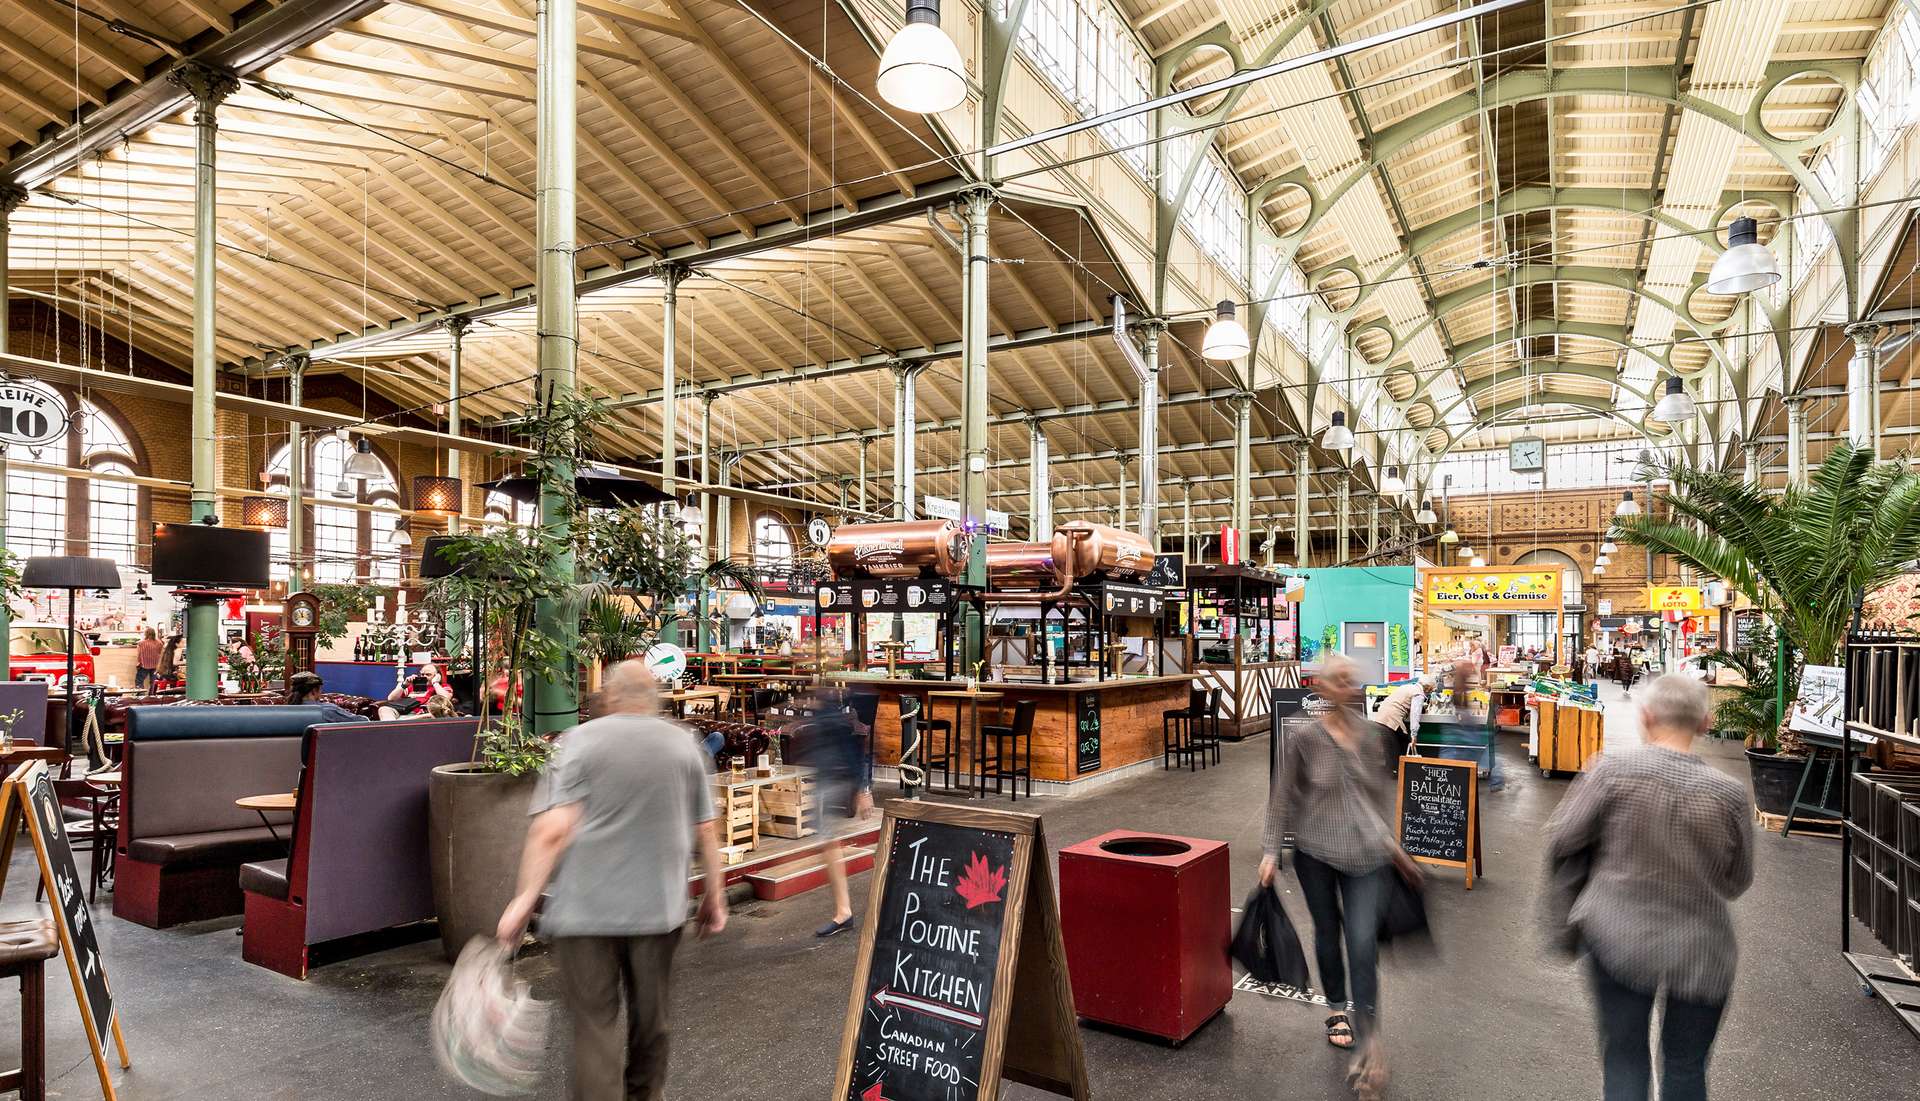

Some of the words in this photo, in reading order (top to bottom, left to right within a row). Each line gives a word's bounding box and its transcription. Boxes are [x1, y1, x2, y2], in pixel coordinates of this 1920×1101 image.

[816, 528, 824, 543] 9
[1436, 592, 1462, 600] Eier,
[1464, 592, 1489, 600] Obst
[1492, 592, 1500, 600] &
[1502, 592, 1547, 600] Gemüse
[1428, 769, 1447, 778] HIER
[1411, 781, 1462, 797] BALKAN
[876, 1043, 919, 1071] STREET
[924, 1057, 960, 1084] FOOD
